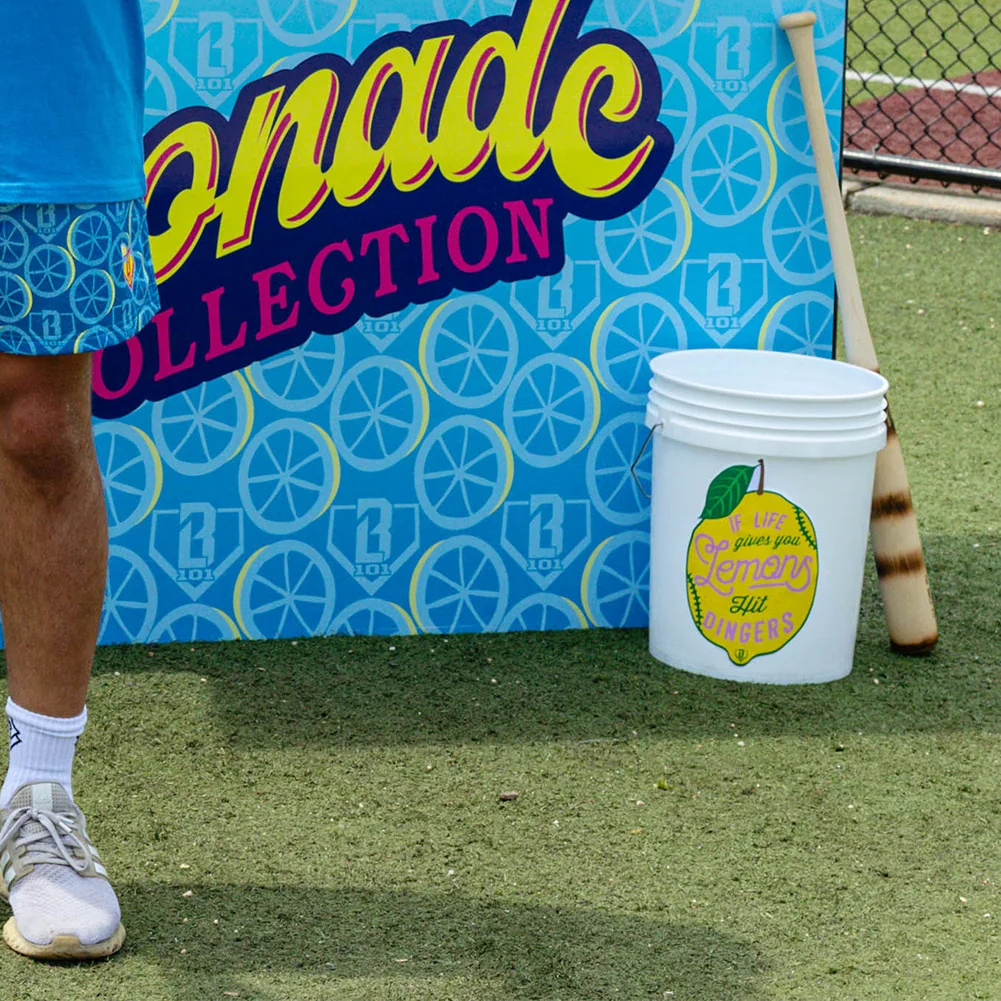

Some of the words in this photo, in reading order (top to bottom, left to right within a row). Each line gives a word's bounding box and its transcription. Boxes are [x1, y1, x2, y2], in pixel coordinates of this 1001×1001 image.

[195, 79, 233, 90] 101
[713, 80, 750, 92] 101
[92, 198, 553, 399] OLLECTION
[363, 320, 401, 332] 101
[535, 318, 572, 331] 101
[704, 316, 740, 329] 101
[729, 514, 742, 533] IF
[754, 511, 788, 531] LIFE
[733, 534, 771, 552] gives
[773, 533, 801, 550] you
[354, 564, 392, 576] 101
[526, 558, 563, 571] 101
[694, 533, 813, 596] Lemons
[176, 568, 215, 581] 101
[729, 595, 769, 616] Hit
[703, 611, 794, 644] DINGERS
